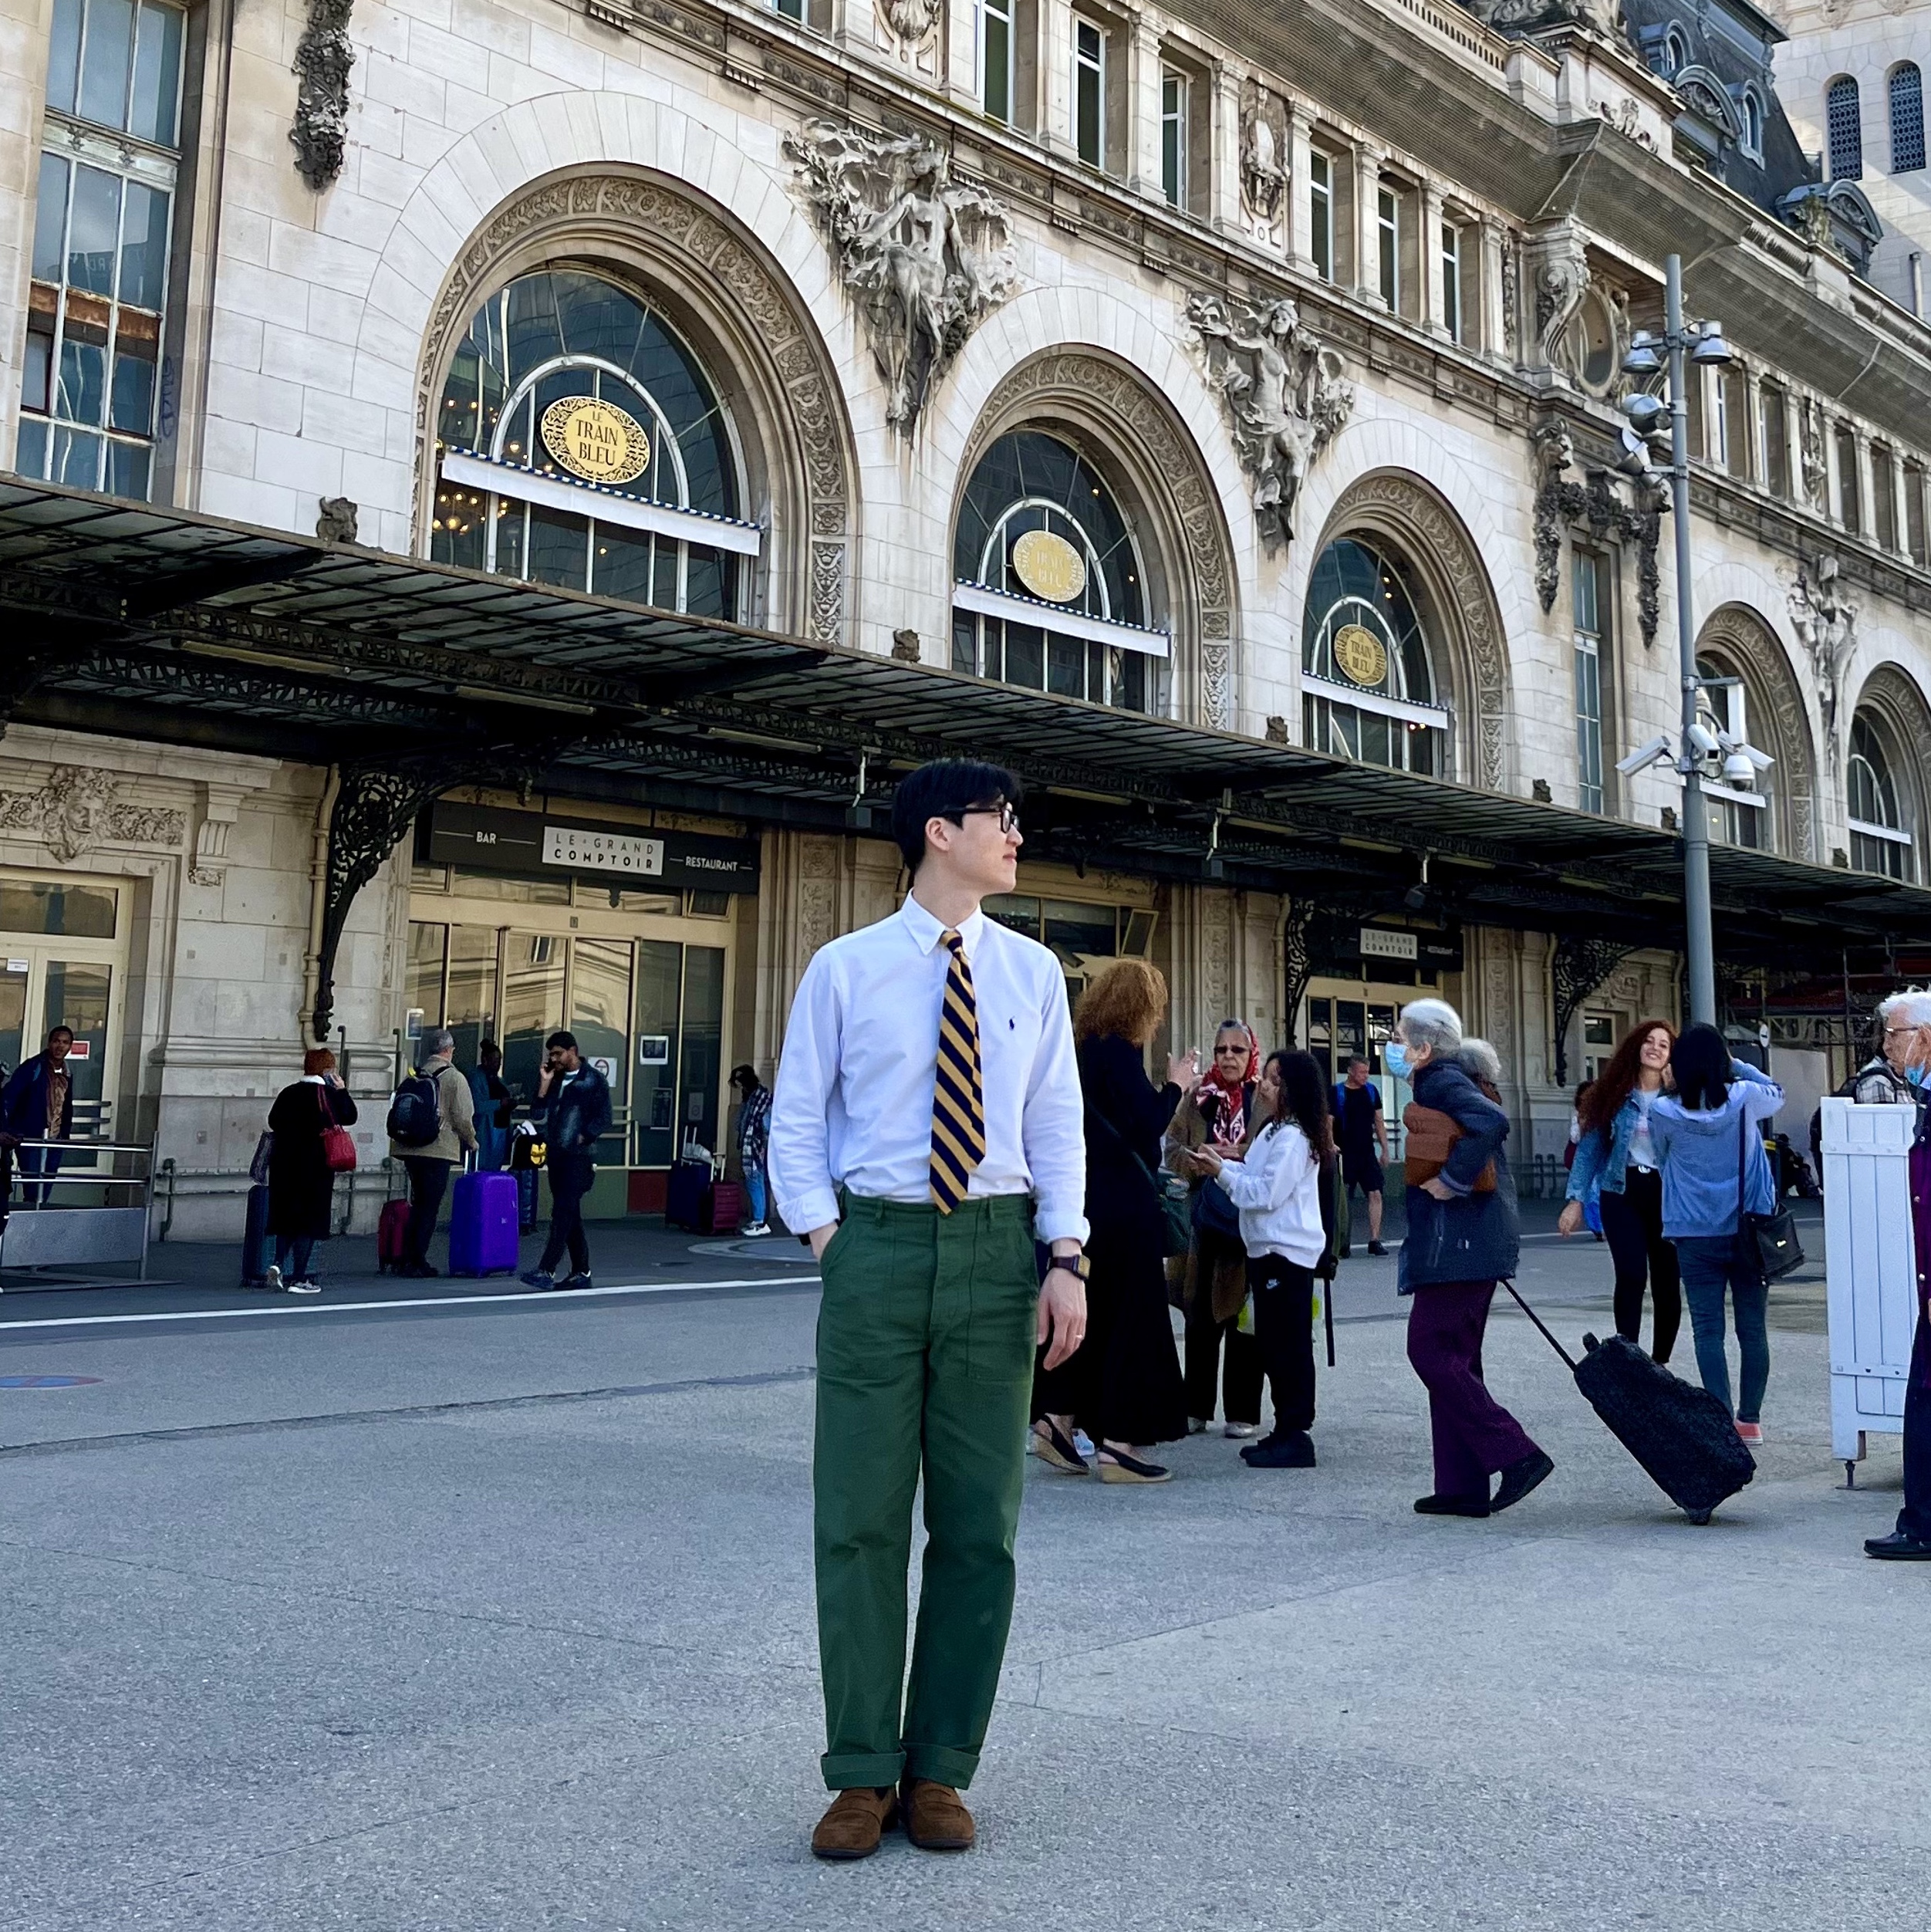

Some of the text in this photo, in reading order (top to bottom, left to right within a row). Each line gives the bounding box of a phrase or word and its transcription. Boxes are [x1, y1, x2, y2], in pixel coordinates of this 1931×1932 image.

[592, 410, 603, 423] LE
[576, 419, 618, 446] TRAIN
[579, 441, 616, 466] BLEU
[476, 831, 496, 845] BAR
[555, 833, 654, 855] LE GRAND
[554, 849, 653, 870] COMPTOIR
[685, 856, 738, 872] RESTAURANT
